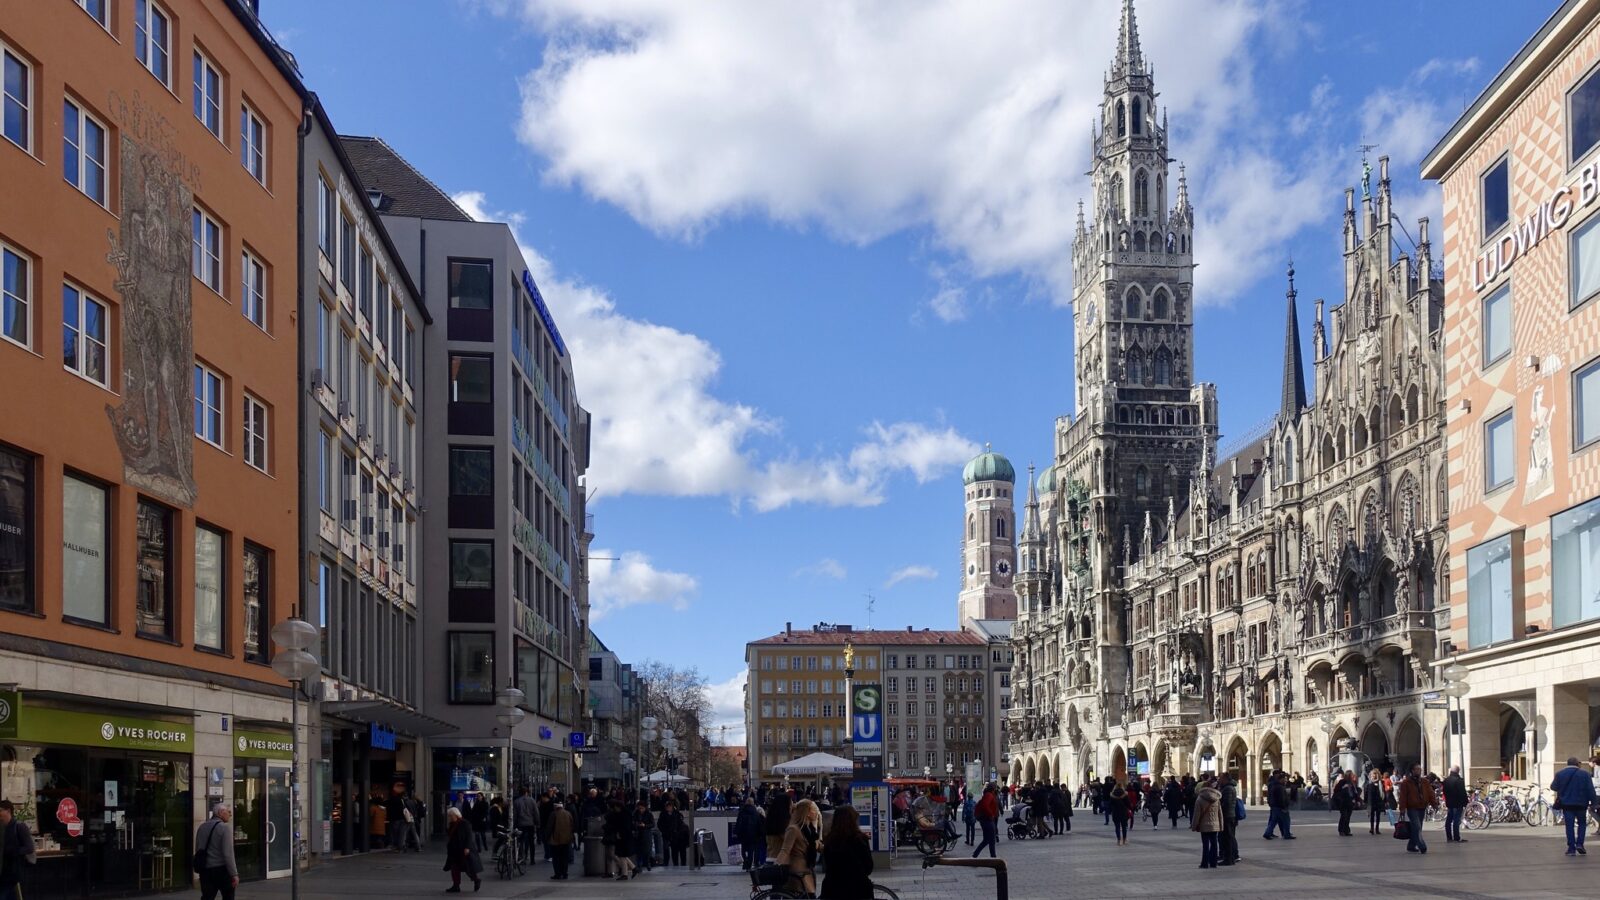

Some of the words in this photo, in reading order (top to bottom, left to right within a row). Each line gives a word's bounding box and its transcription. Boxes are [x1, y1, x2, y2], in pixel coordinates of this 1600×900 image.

[1472, 187, 1574, 293] LUDWIG
[0, 522, 22, 536] UBER
[63, 541, 99, 558] HALLHUBER
[858, 688, 877, 711] S
[117, 726, 144, 739] YVES
[147, 728, 187, 743] ROCHER
[859, 717, 876, 739] U
[248, 739, 266, 749] YVES
[267, 740, 294, 751] ROCHER
[1129, 748, 1136, 757] S
[1129, 758, 1136, 766] U
